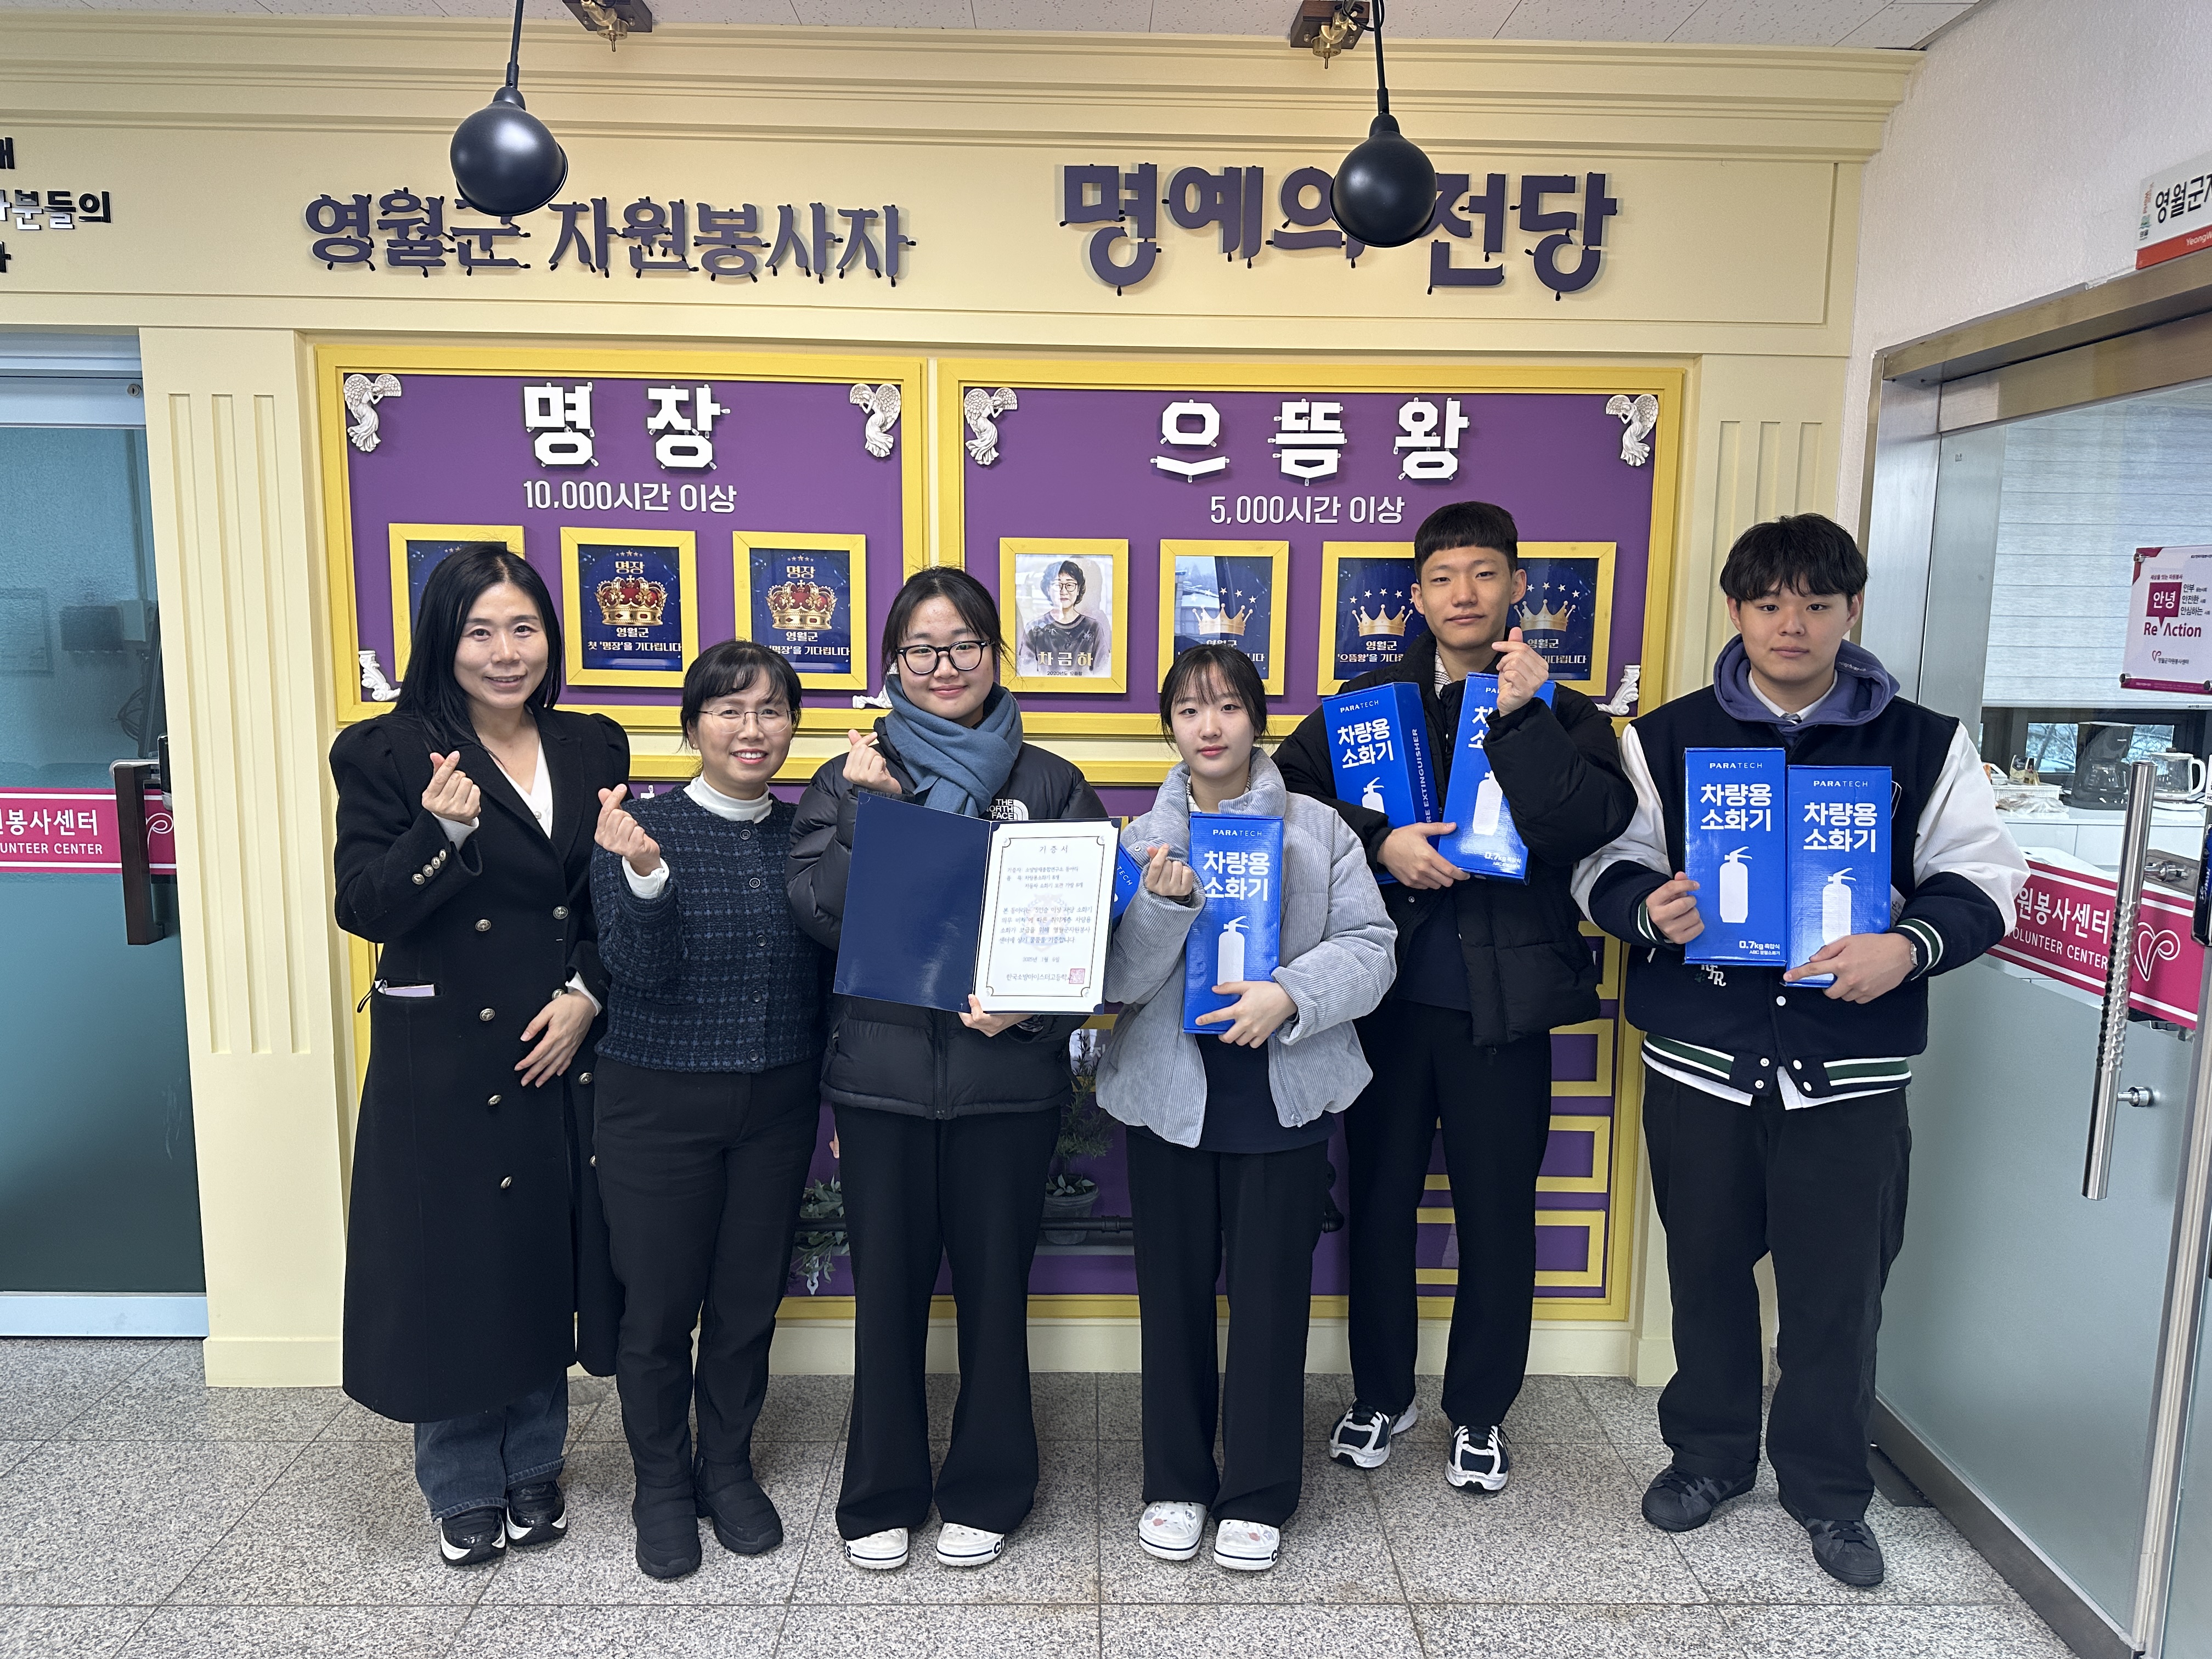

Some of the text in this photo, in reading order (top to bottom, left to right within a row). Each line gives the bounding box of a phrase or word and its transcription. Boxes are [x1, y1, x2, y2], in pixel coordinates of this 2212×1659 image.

[0, 190, 111, 230] 분들의
[306, 188, 916, 287] 영월군 자원봉사자
[1060, 162, 1617, 300] 명예의 전당
[680, 484, 737, 513] 이상
[1210, 495, 1405, 524] 5,000시간 이상
[615, 561, 645, 574] 명장
[786, 566, 815, 579] 명장
[2183, 584, 2194, 592] 안부
[2153, 591, 2176, 609] 안녕
[2182, 595, 2199, 604] 안전한
[2180, 606, 2203, 616] 안심하는
[616, 627, 649, 638] 영월군
[786, 631, 818, 642] 영월군
[2143, 622, 2158, 636] Re
[588, 641, 597, 651] 첫
[635, 642, 681, 652] 기다립니다
[804, 646, 850, 656] 기다립니다
[1365, 641, 1397, 651] 영월군
[1527, 639, 1559, 648] 영월군
[1340, 700, 1379, 713] PARATECH
[1338, 718, 1390, 746] 차량용
[1342, 740, 1394, 769] 소화기
[1412, 729, 1429, 807] EXTINGUISHER
[1700, 783, 1772, 806] 차량용
[1701, 809, 1771, 832] 소화기
[1803, 802, 1878, 827] 차량용
[0, 842, 103, 855] UNTEER CENTER
[1803, 828, 1876, 853] 소화기
[1203, 850, 1270, 876] 차량용
[1204, 877, 1268, 901] 소화기
[1739, 940, 1763, 950] 0.7kg
[2067, 944, 2108, 970] CENTER
